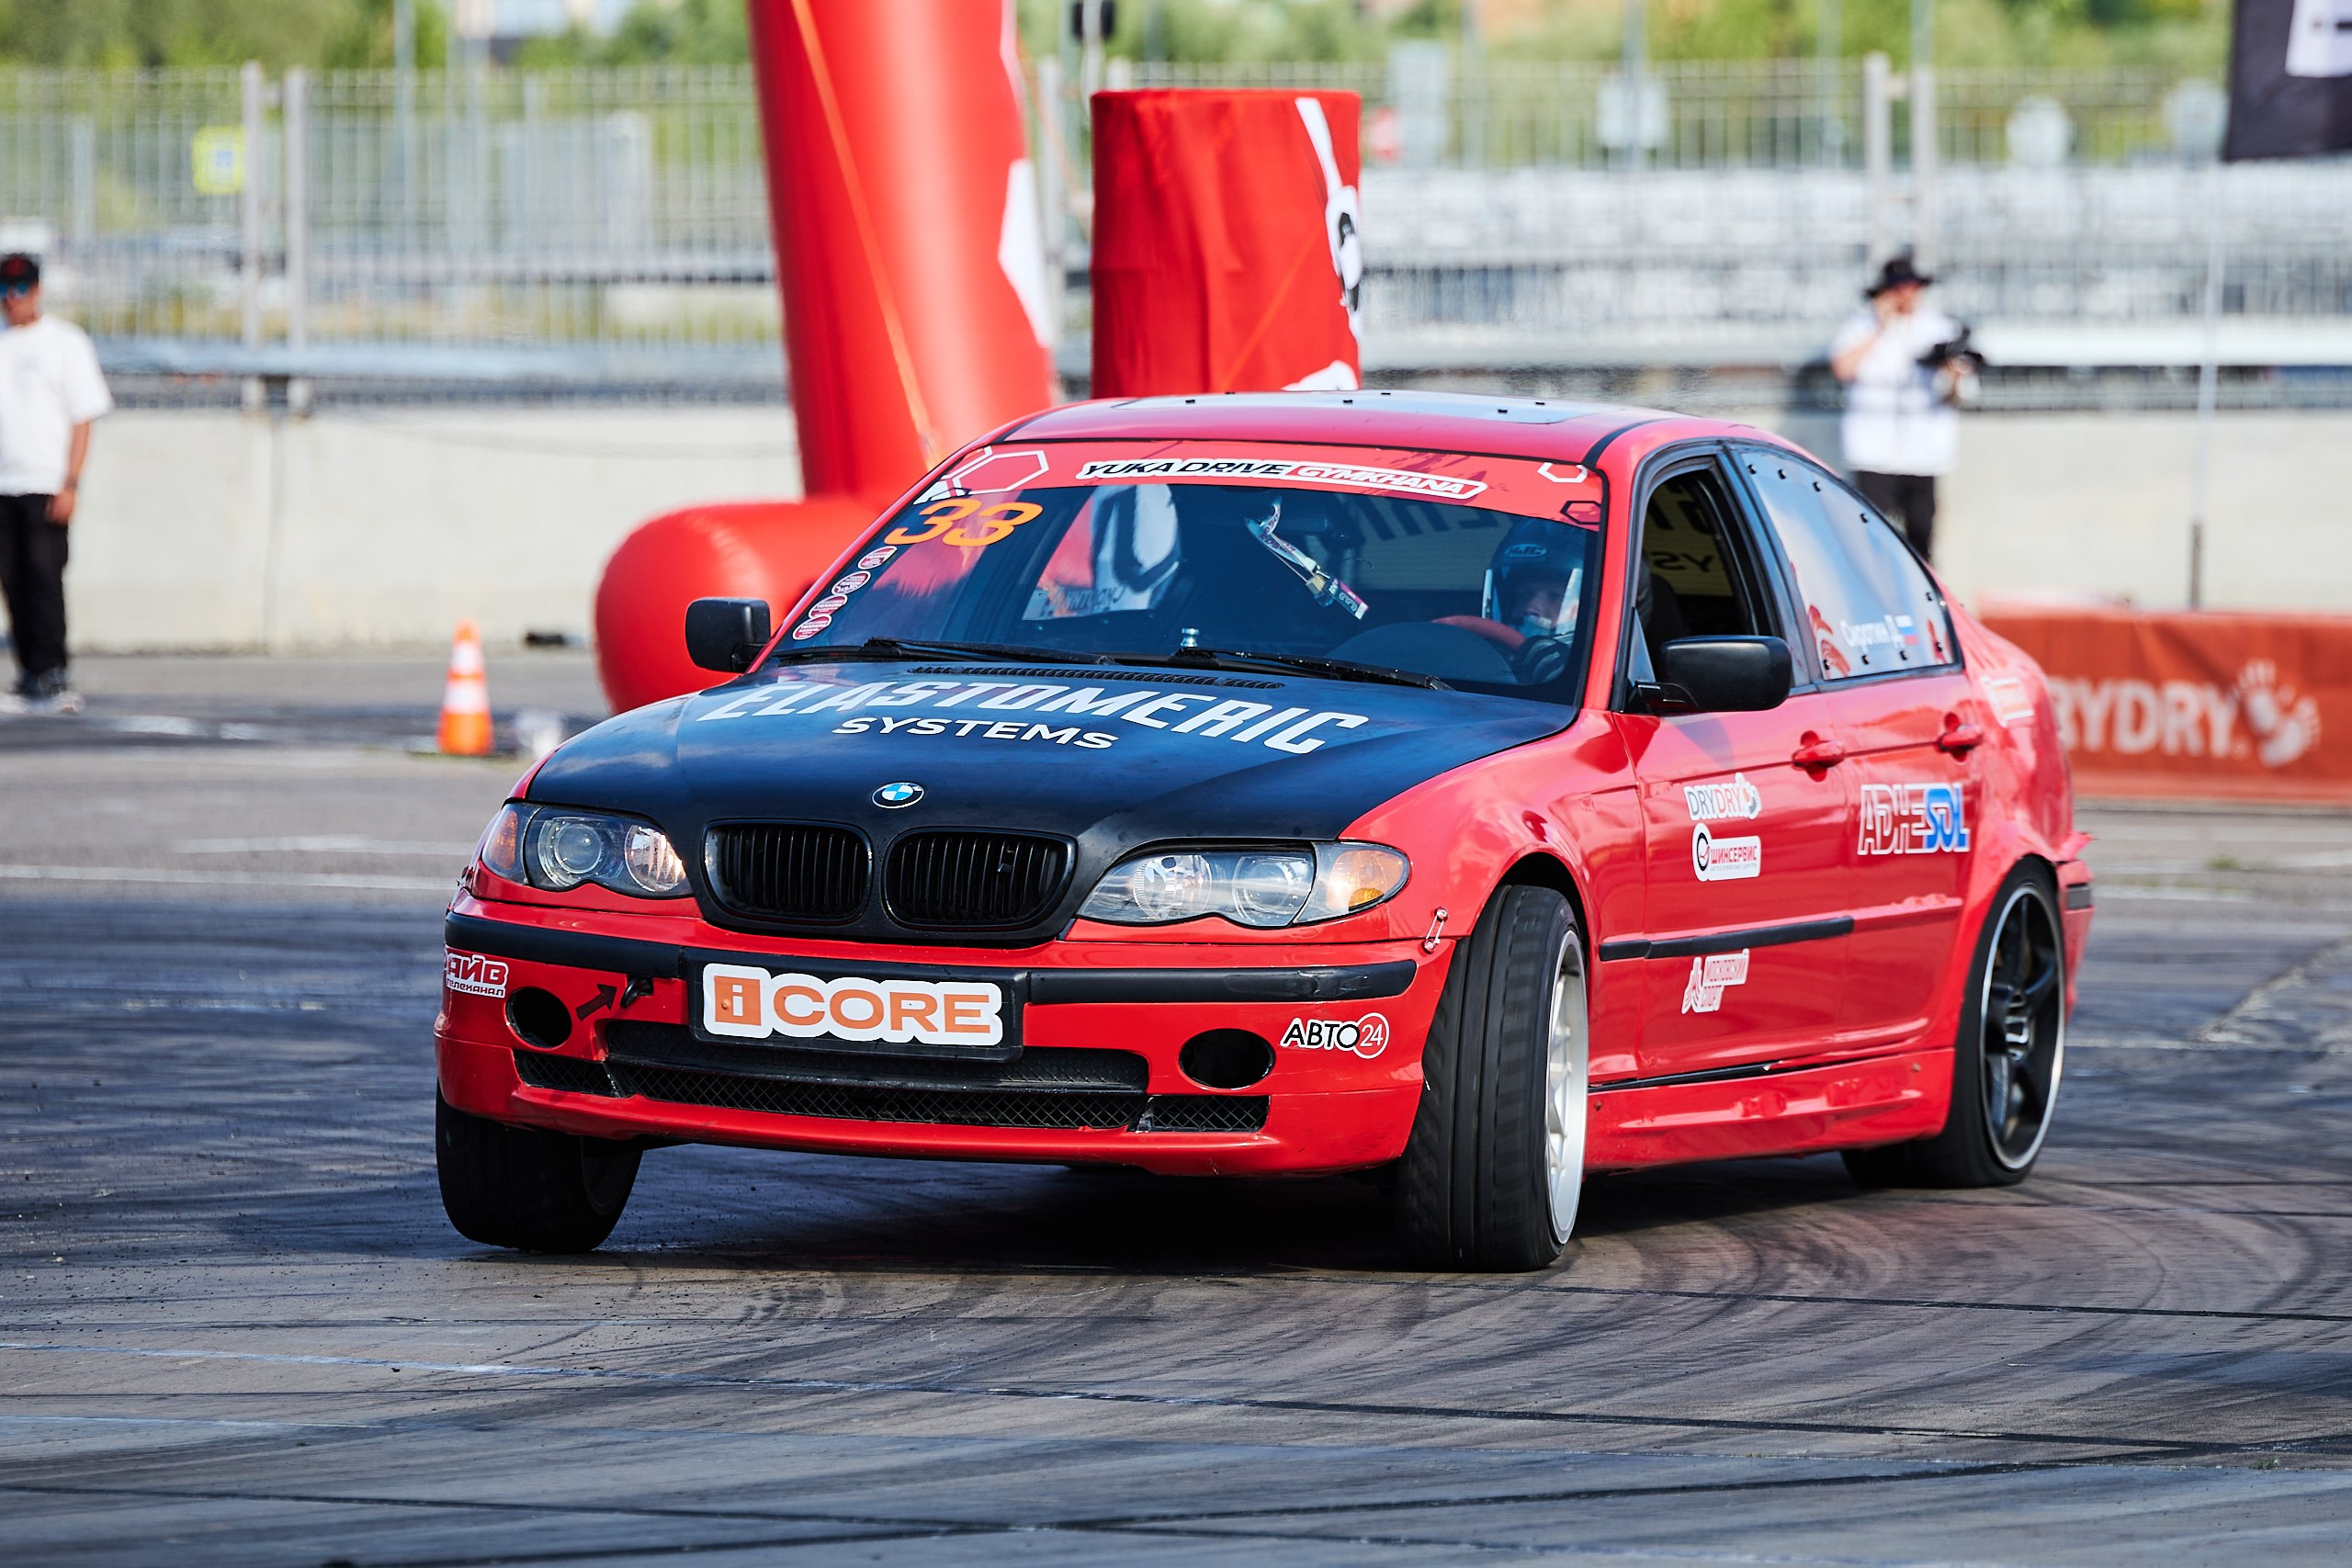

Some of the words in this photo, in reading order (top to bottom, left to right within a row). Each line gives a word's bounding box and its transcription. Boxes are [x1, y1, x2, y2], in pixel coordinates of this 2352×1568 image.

[1085, 462, 1172, 475] YUKA
[1178, 462, 1291, 475] DRIVE
[1296, 465, 1467, 493] GYMKHANA
[883, 498, 1044, 547] 33
[696, 681, 1369, 755] ELASTOMERIC
[831, 716, 1119, 750] SYSTEMS
[2048, 676, 2238, 760] RYDRY
[1686, 788, 1743, 817] DRYDRY
[1710, 845, 1758, 864] ШИНСЕРВИС
